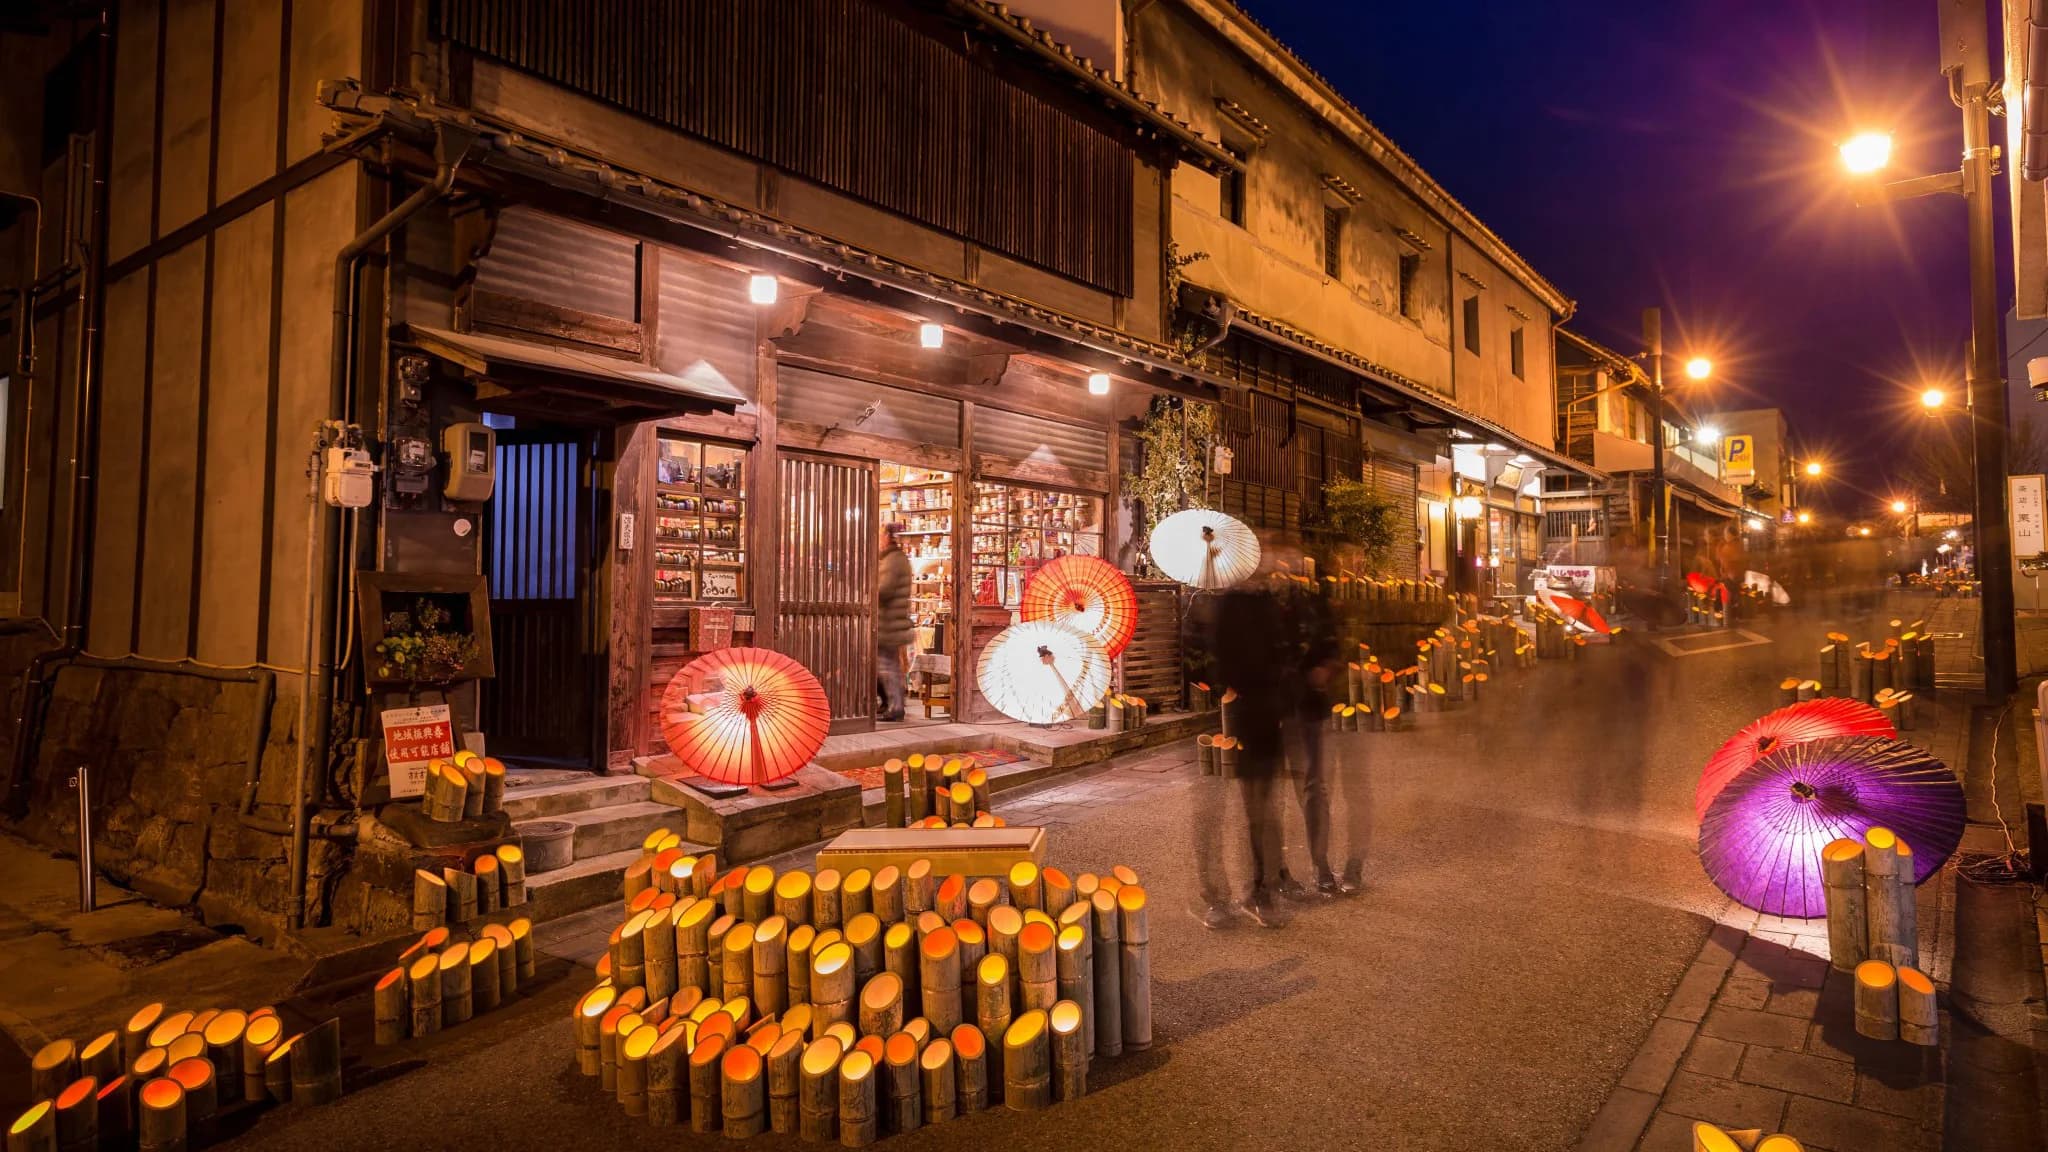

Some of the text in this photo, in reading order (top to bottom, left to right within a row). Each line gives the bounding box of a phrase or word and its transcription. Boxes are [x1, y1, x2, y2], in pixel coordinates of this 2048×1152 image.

[1729, 440, 1745, 462] P
[389, 741, 451, 760] 使用可能店舗
